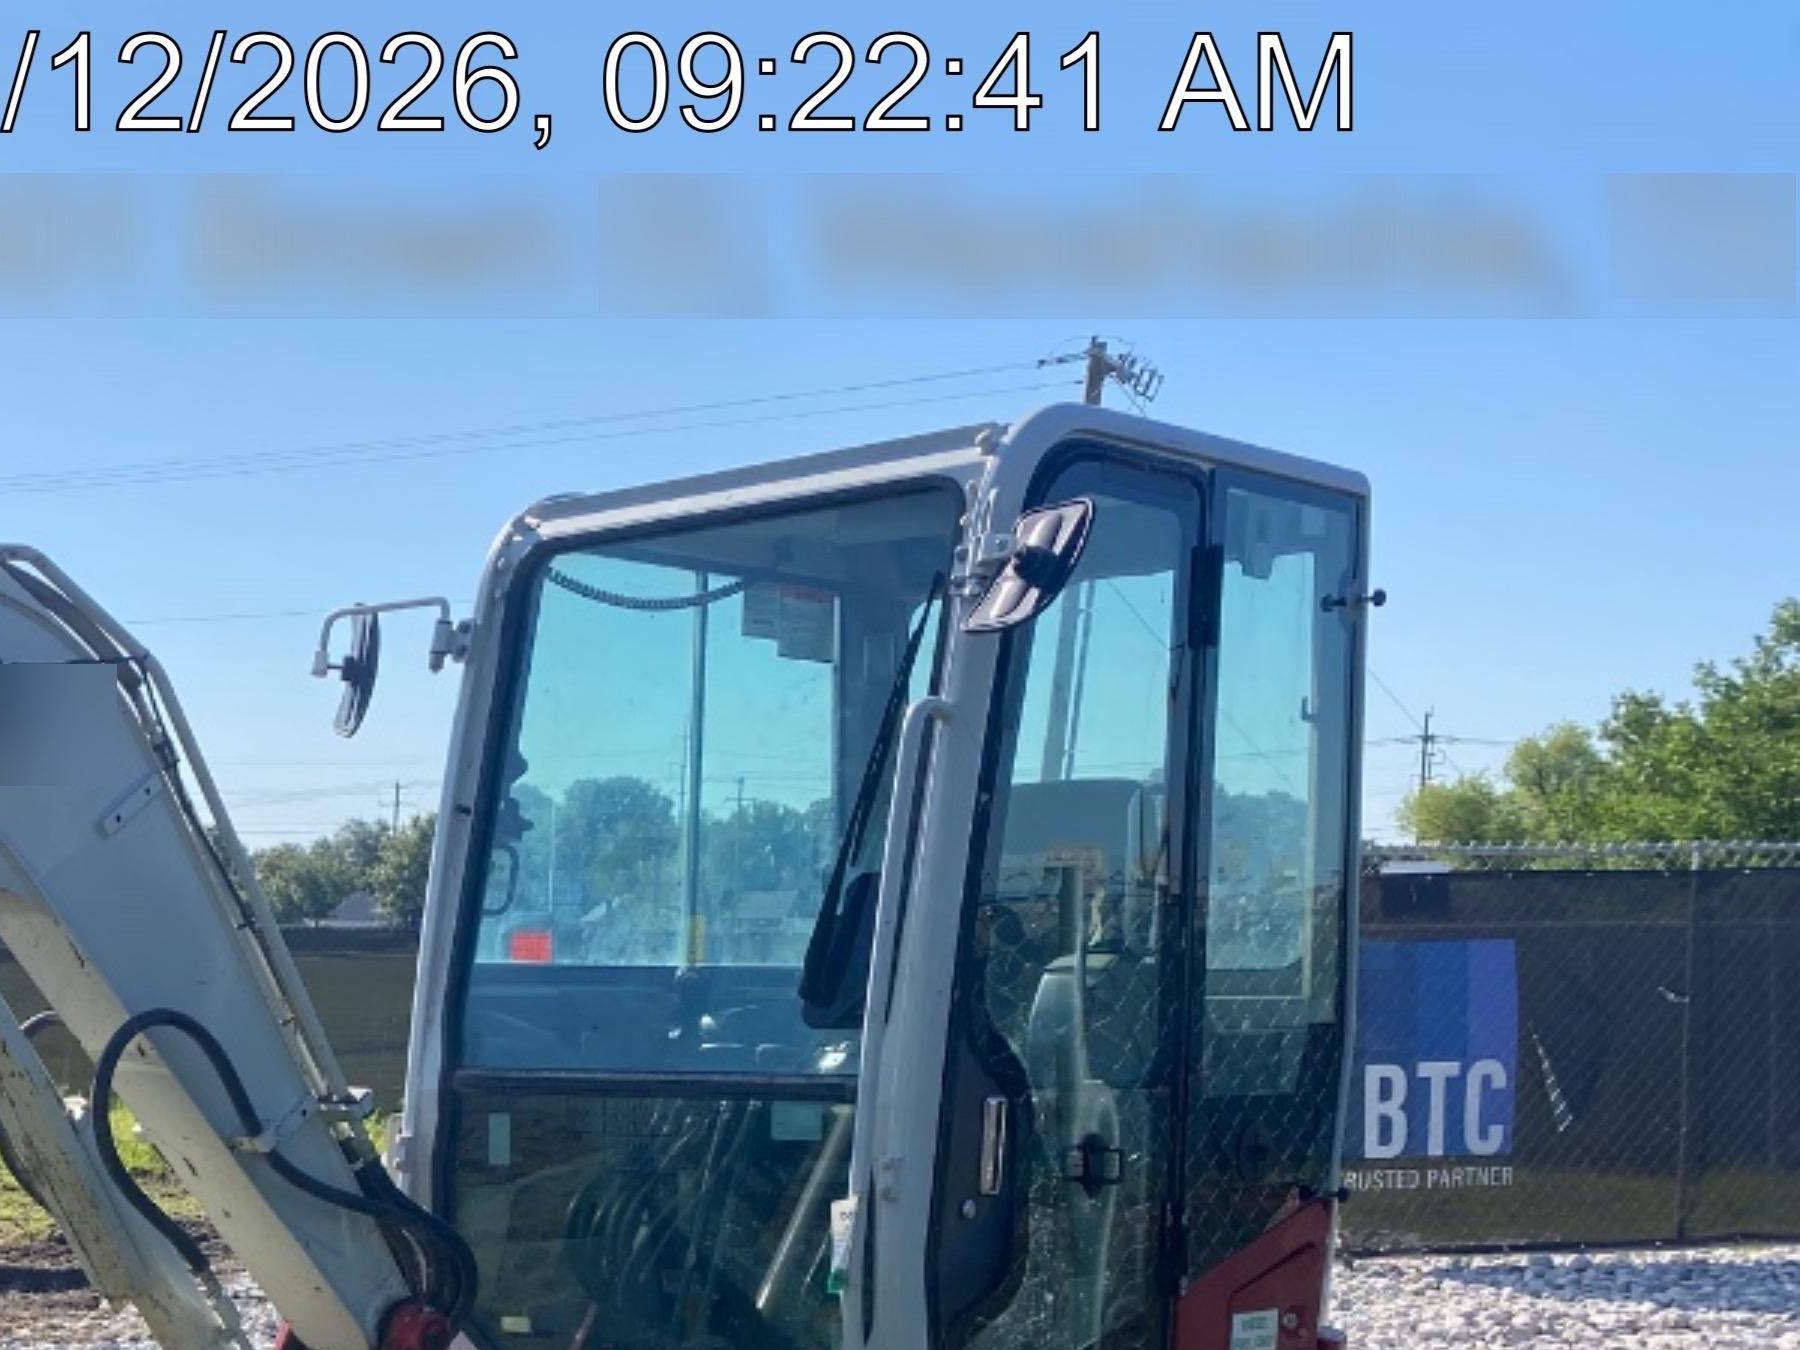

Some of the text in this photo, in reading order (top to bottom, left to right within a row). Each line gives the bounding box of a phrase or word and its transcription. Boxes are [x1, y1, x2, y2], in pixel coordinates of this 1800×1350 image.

[1364, 1058, 1507, 1159] BTC
[1341, 1167, 1513, 1192] RUSTED PARTNER
